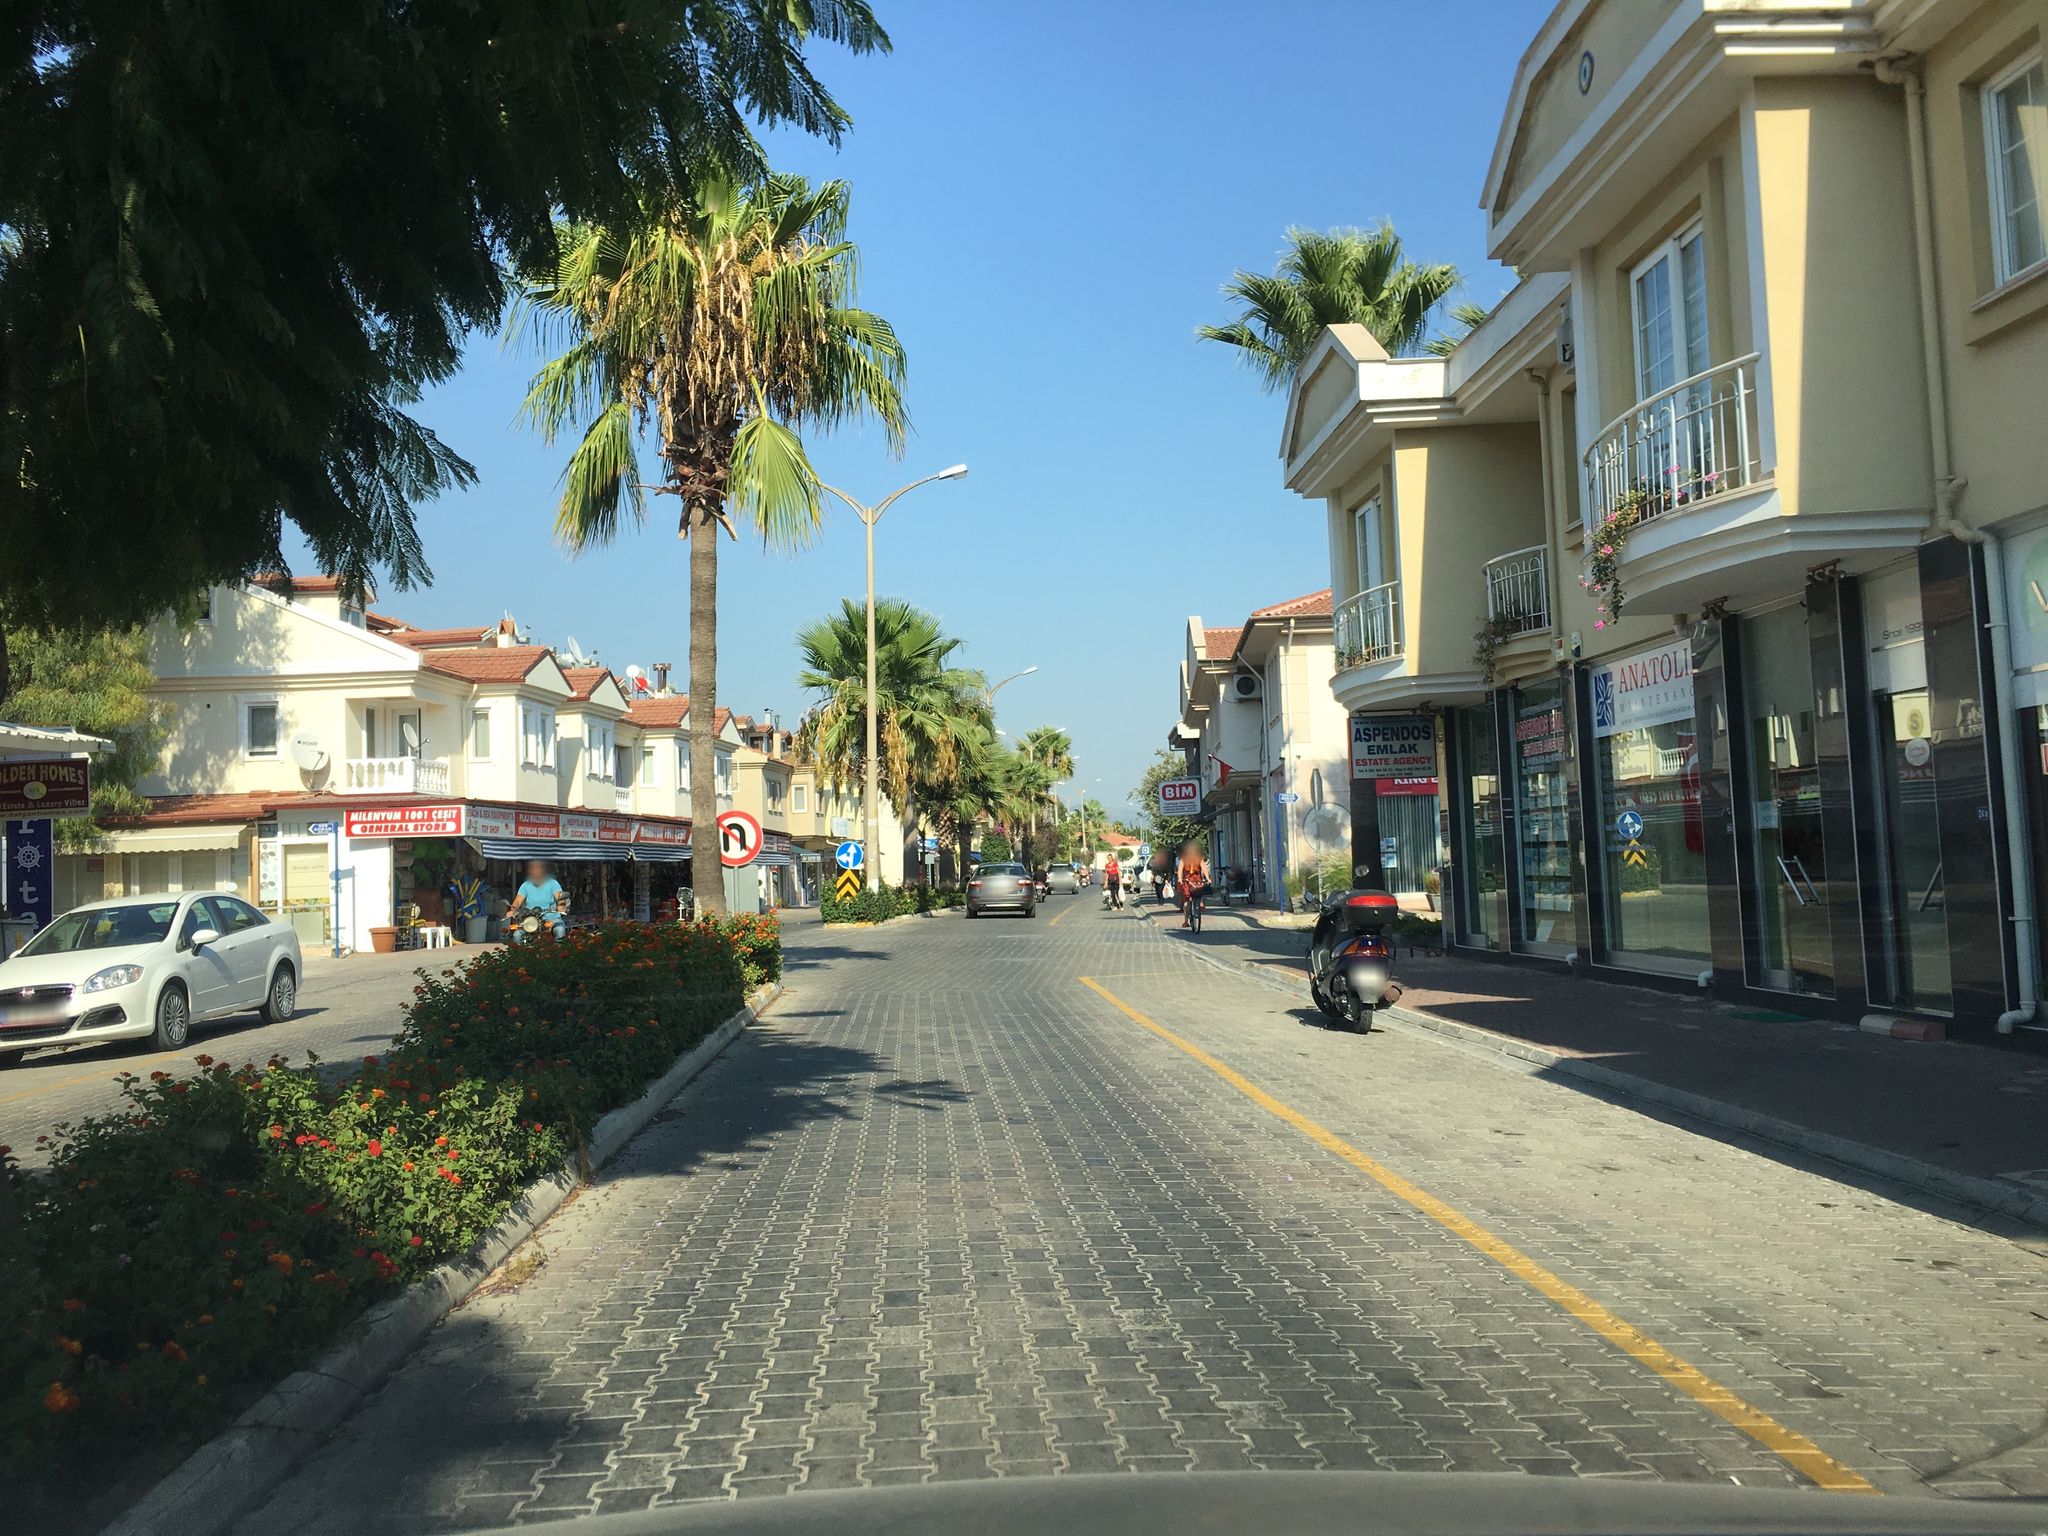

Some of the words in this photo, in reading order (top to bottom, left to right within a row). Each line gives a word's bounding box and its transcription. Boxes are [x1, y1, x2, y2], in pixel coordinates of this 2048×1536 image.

[1619, 647, 1692, 694] ANATOLI
[1354, 725, 1432, 742] ASPENDOS
[1367, 743, 1419, 755] EMLAK
[1356, 758, 1391, 767] ESTATE
[1392, 756, 1432, 765] AGENCY
[40, 764, 85, 785] HOMES
[1165, 783, 1194, 798] BİM
[64, 799, 86, 807] Villas
[349, 810, 402, 822] MİLENYUM
[405, 810, 428, 820] 1001
[432, 809, 458, 822] ÇEŞİT
[360, 824, 409, 833] GENERAL
[413, 823, 447, 832] STORE
